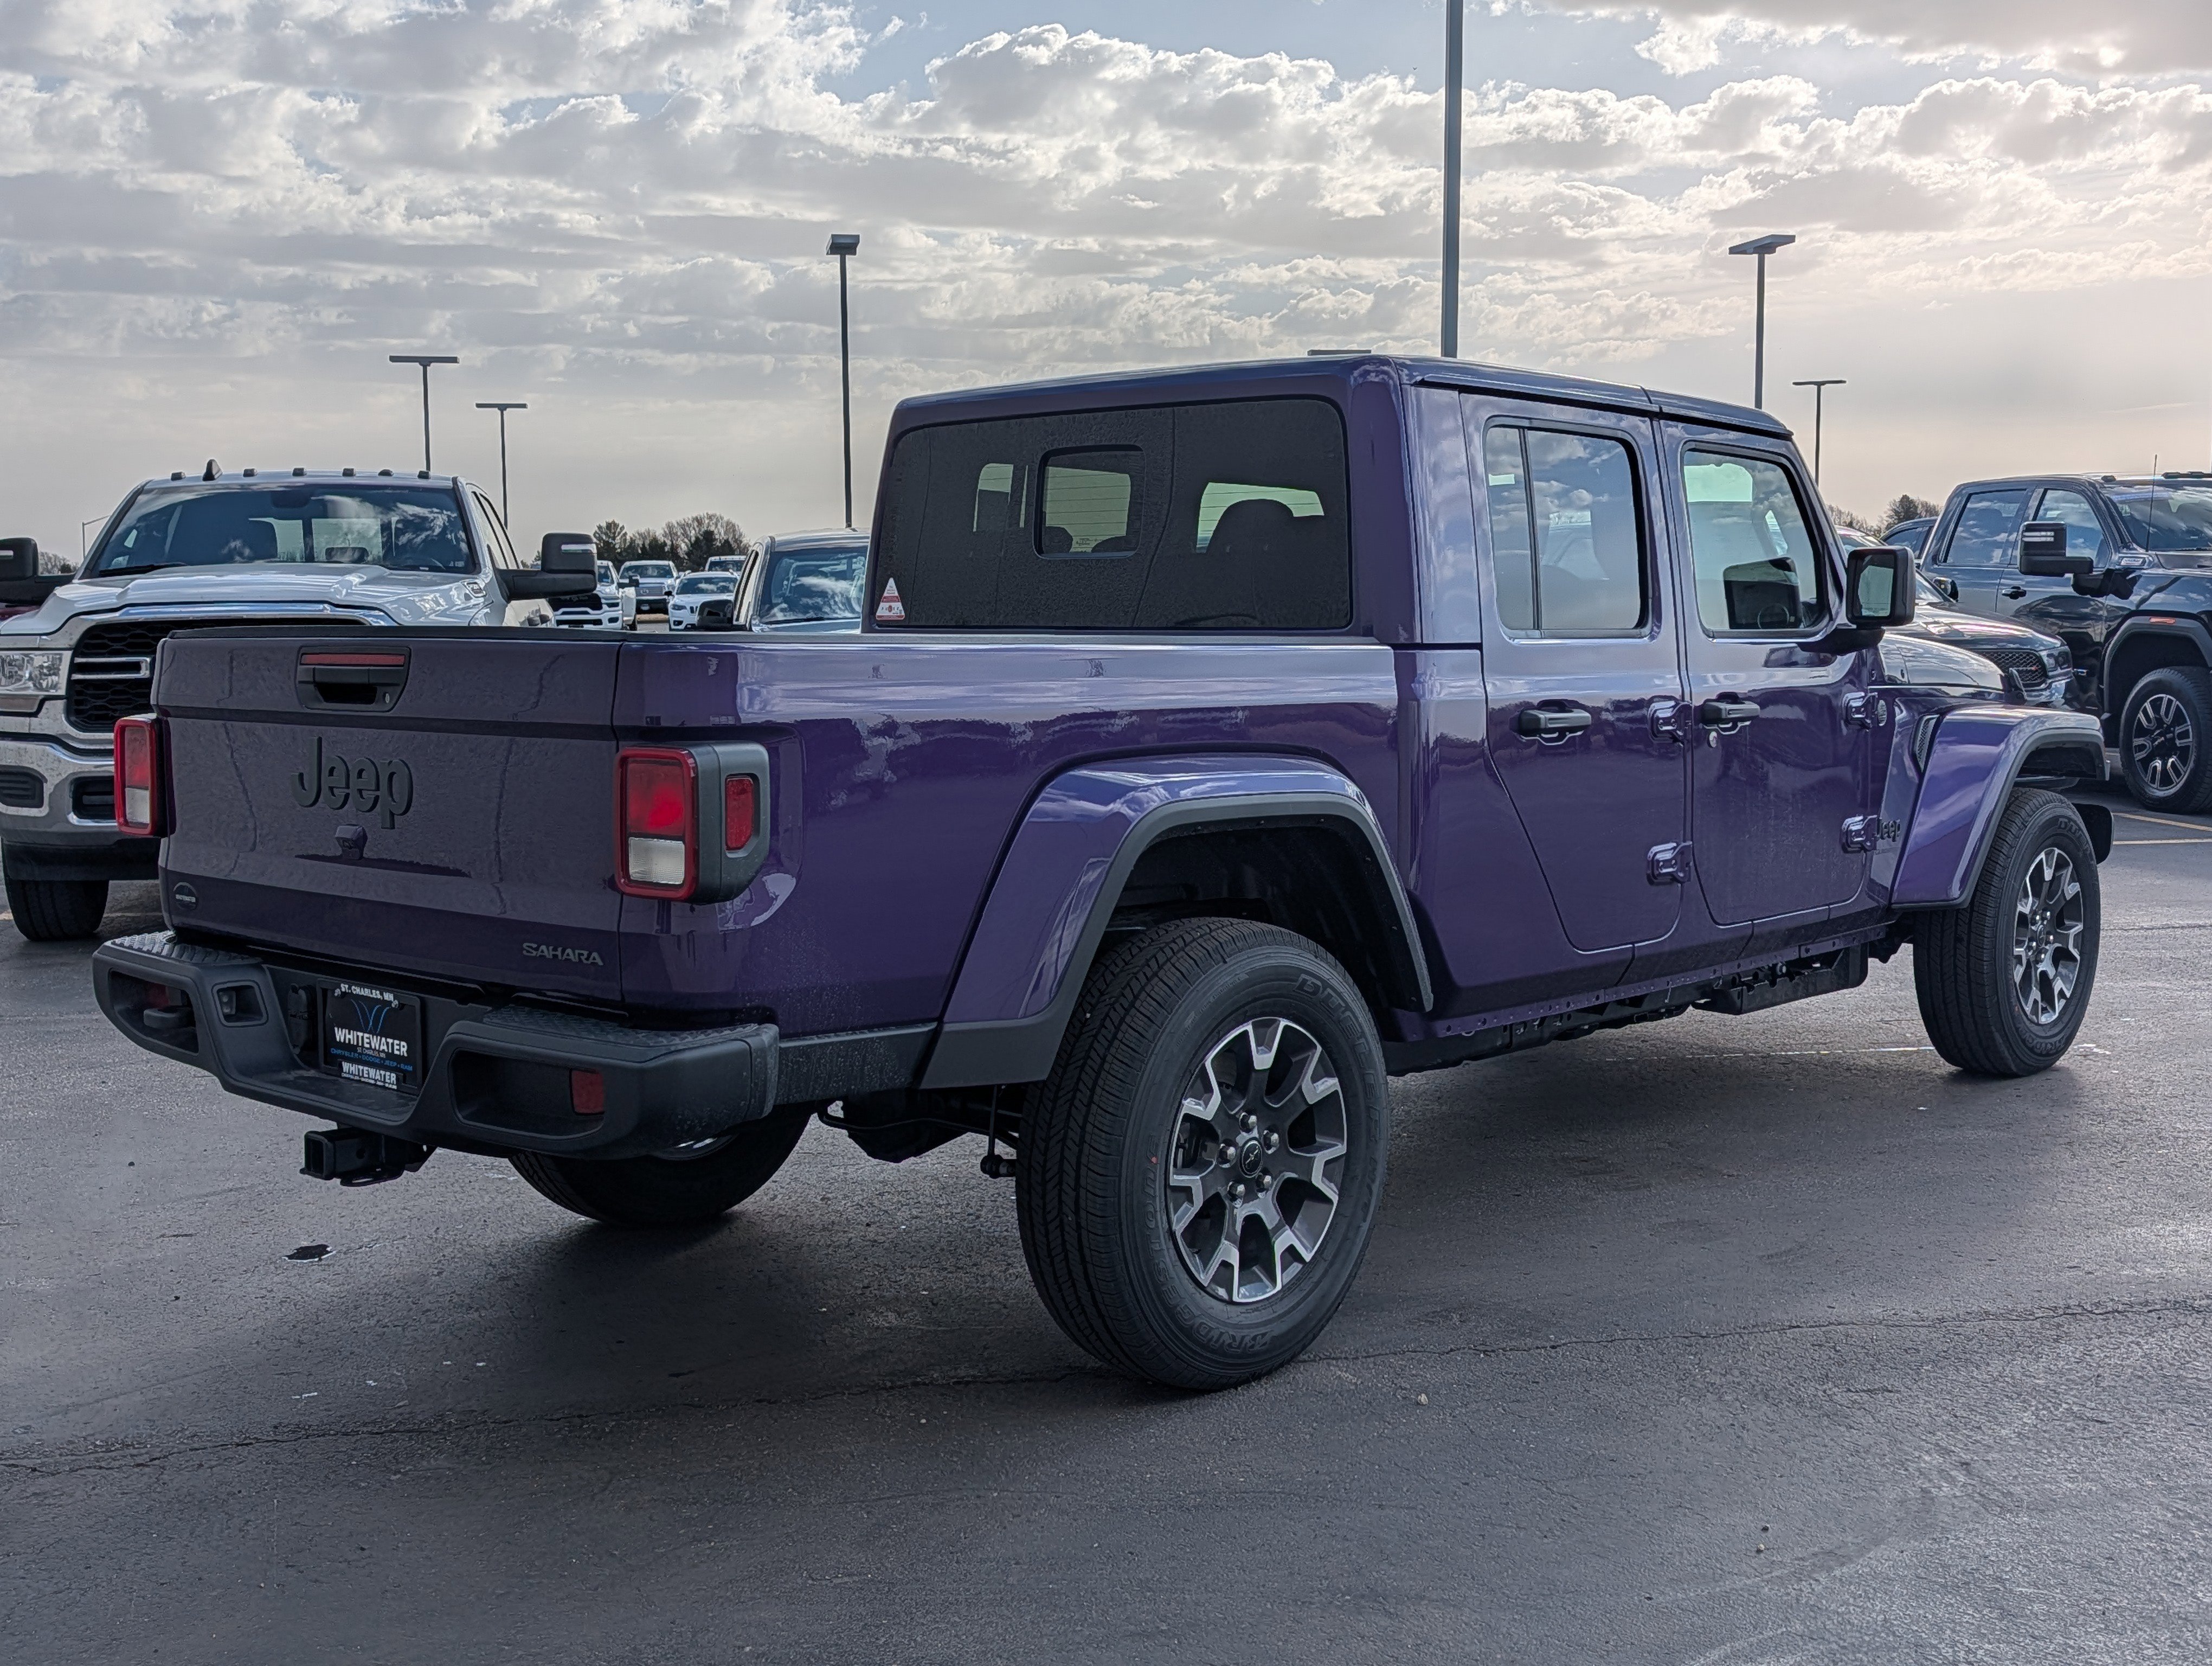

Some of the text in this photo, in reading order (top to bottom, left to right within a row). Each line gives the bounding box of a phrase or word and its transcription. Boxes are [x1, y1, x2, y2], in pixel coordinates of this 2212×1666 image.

[291, 736, 414, 830] Jeep
[522, 942, 604, 966] SAHARA
[340, 983, 351, 993] ST.
[352, 985, 383, 1001] CHARLES,
[334, 1026, 408, 1057] WHITEWATER
[342, 1061, 397, 1085] WHITEWATER
[1292, 972, 1380, 1143] DUELER
[1142, 1133, 1277, 1354] BRIDGESTONE
